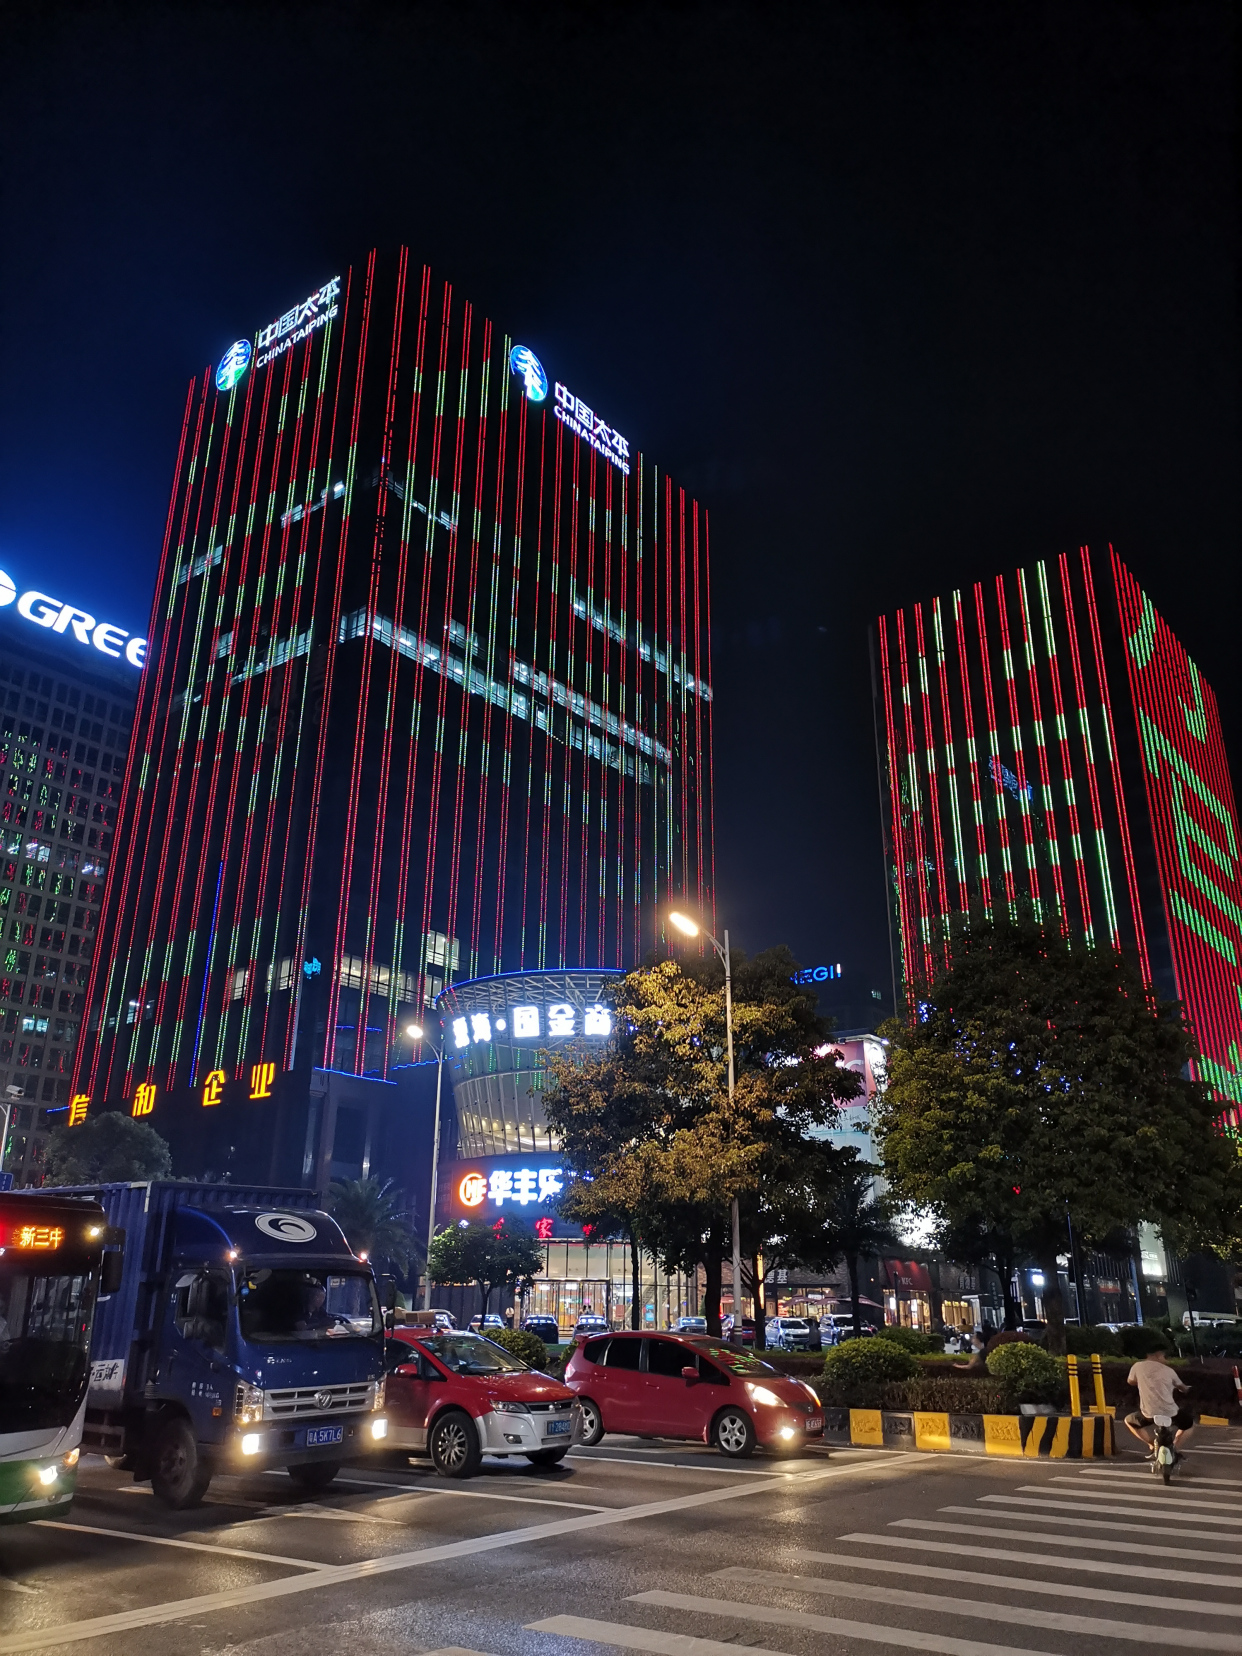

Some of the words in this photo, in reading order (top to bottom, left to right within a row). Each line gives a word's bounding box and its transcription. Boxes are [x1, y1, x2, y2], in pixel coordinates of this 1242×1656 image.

[555, 381, 630, 457] 中国太平
[17, 590, 147, 668] GREE
[68, 1062, 276, 1127] 信和企业
